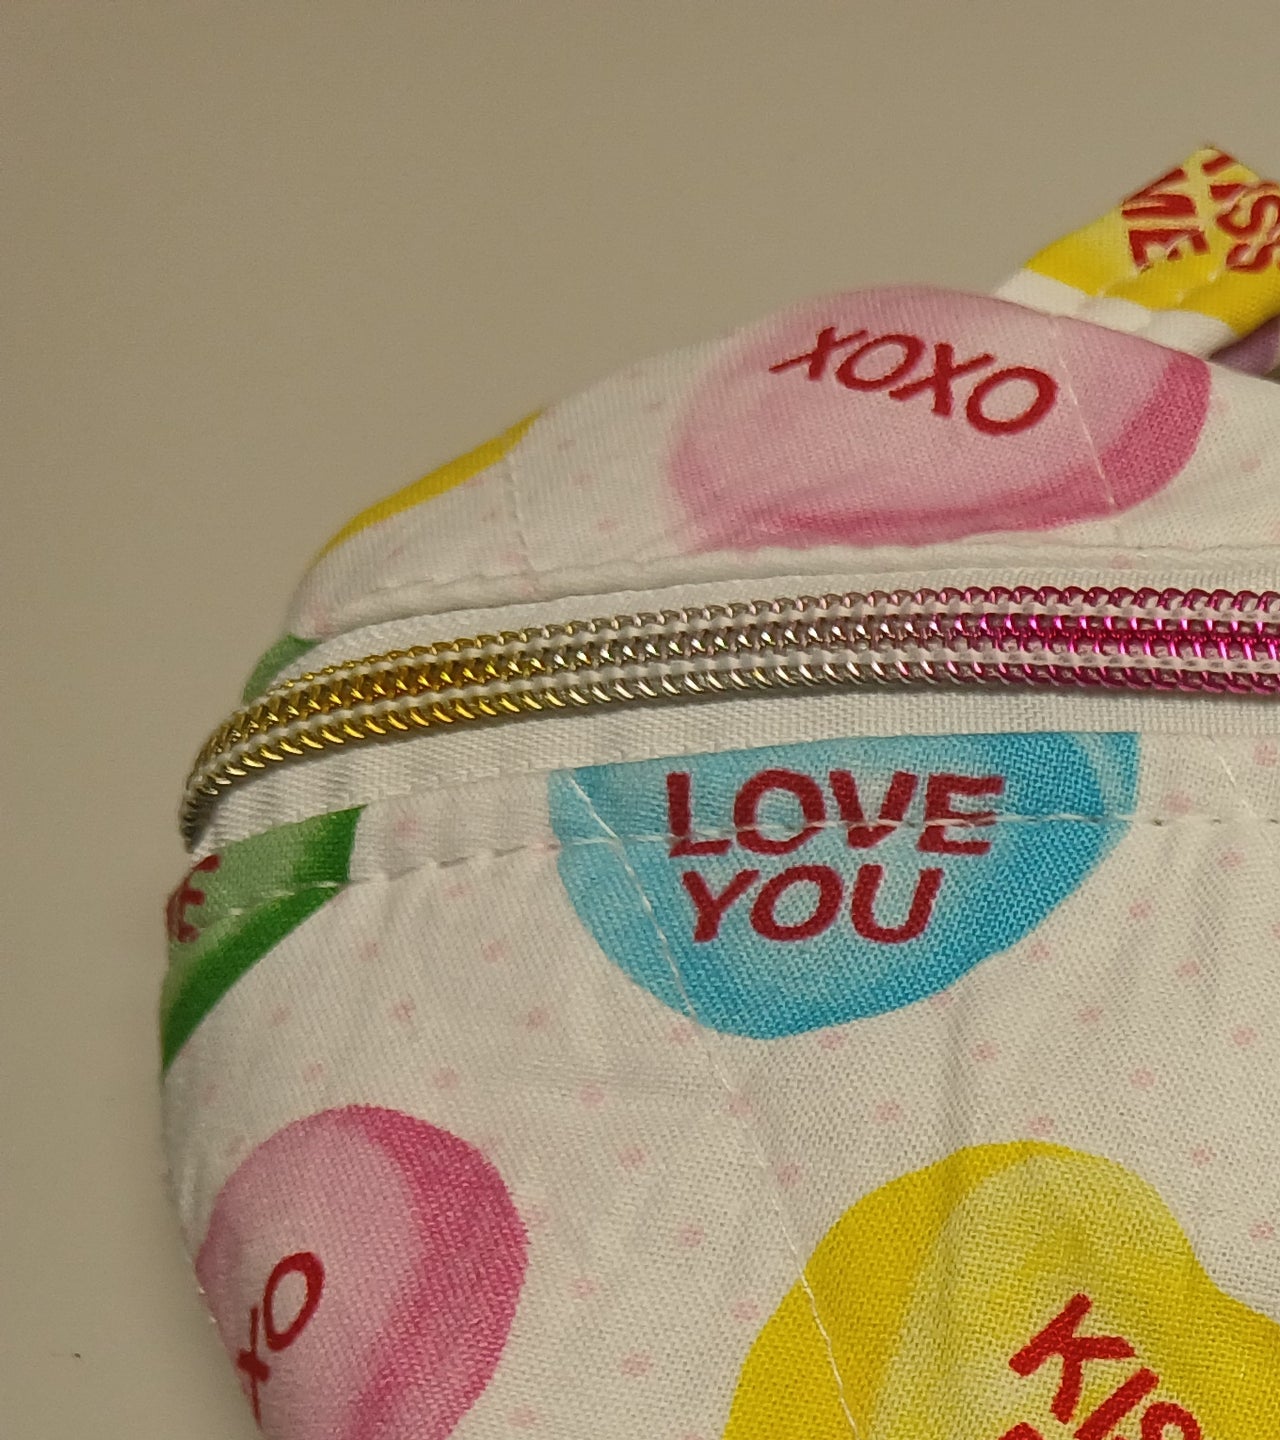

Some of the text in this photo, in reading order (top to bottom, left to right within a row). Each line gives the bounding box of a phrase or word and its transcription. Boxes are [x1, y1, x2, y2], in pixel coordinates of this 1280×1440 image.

[769, 326, 1059, 436] XOXO
[666, 768, 1004, 858] LOVE
[682, 863, 944, 943] YOU
